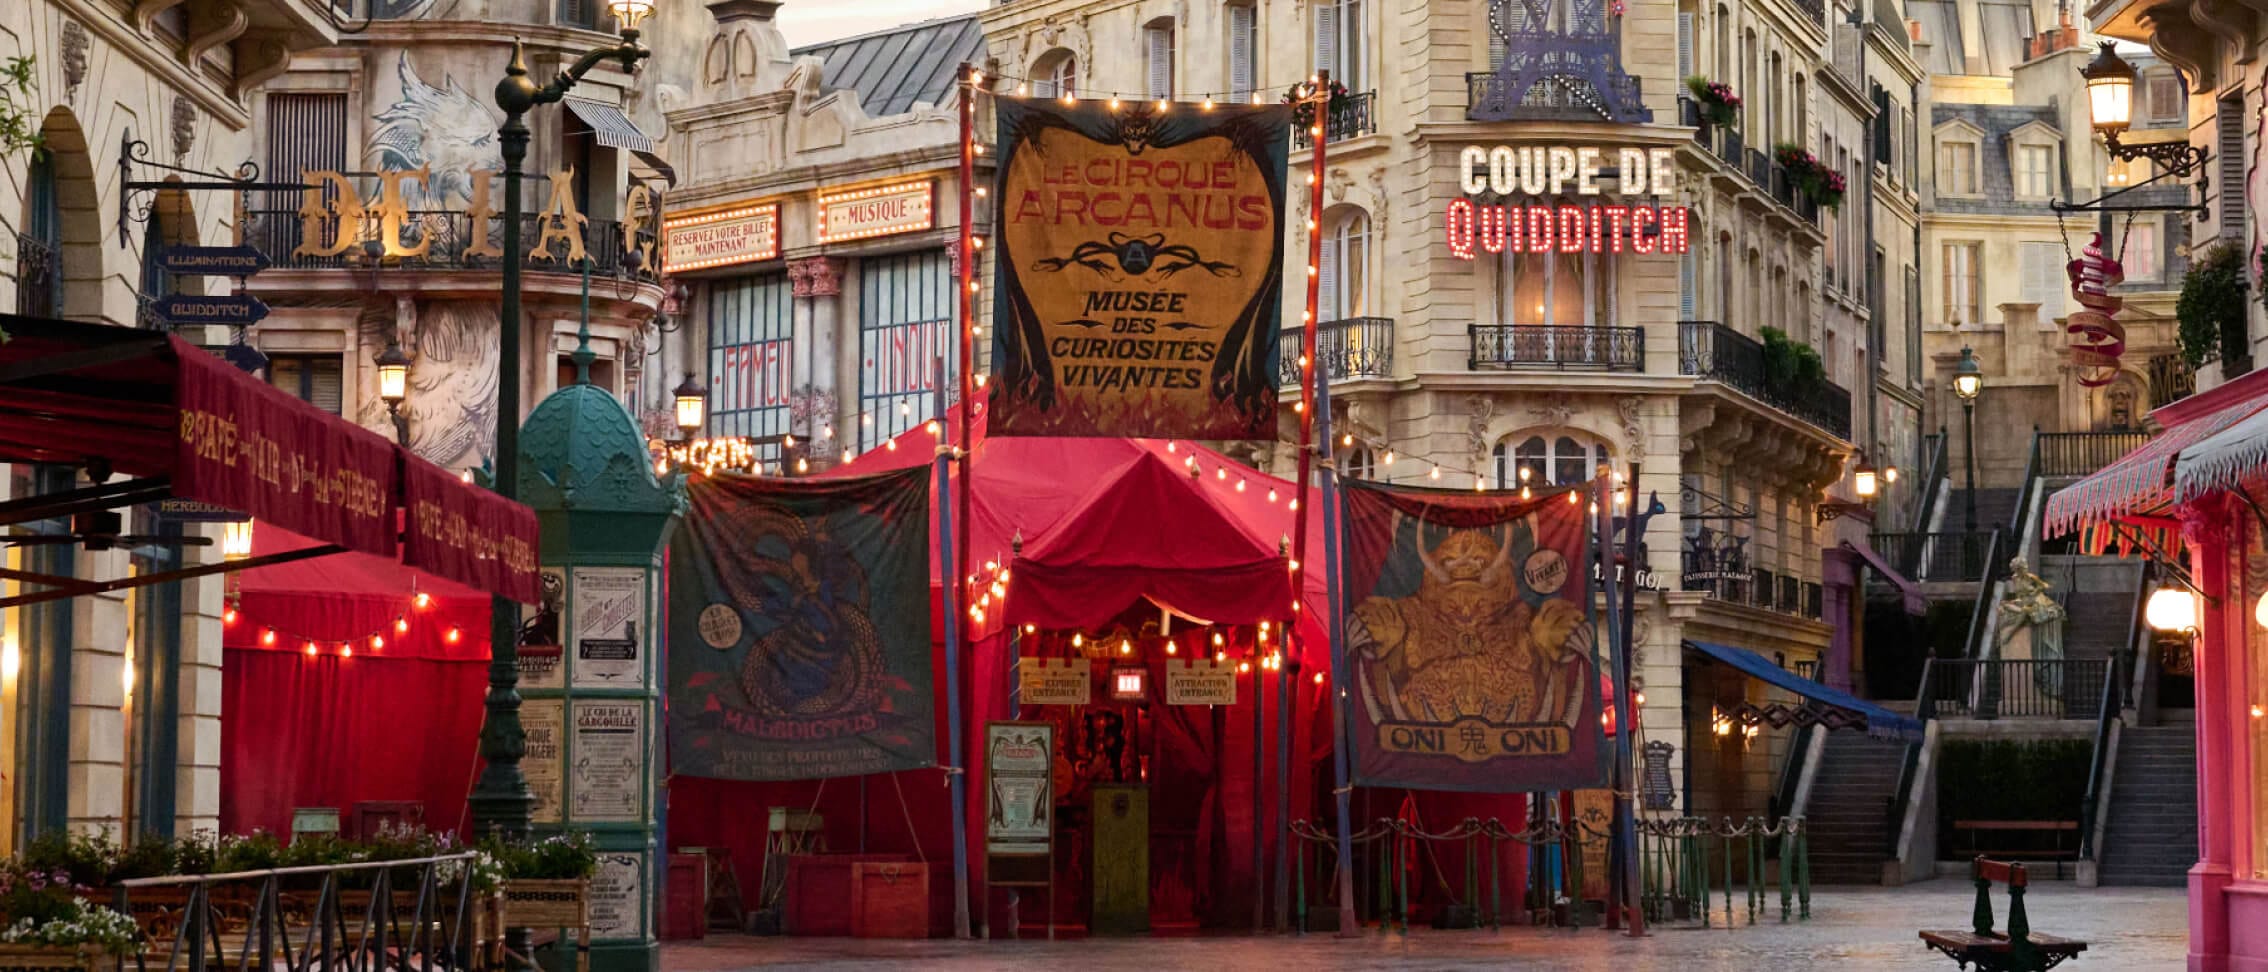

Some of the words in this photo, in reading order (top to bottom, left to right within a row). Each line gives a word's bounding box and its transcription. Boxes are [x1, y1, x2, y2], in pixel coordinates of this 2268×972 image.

[1042, 163, 1075, 186] LE
[1081, 158, 1237, 190] CIRQUE
[1460, 145, 1600, 195] COUPE
[1618, 147, 1673, 195] DE
[849, 199, 908, 225] MUSIQUE
[1013, 189, 1268, 231] ARCANUS
[715, 226, 741, 240] VOTRE
[743, 222, 769, 236] BILLET
[1446, 196, 1689, 260] QUIDDITCH
[694, 237, 747, 257] MAINTENANT
[171, 303, 249, 316] QUIDDITCH
[1083, 287, 1187, 317] MUSÉE
[1111, 317, 1156, 335] DES
[1051, 333, 1217, 363] CURIOSITÉS
[1062, 365, 1202, 393] VIVANTES
[1179, 688, 1224, 698] ENTRANCE
[1391, 727, 1445, 752] ONI
[1459, 723, 1489, 755] 鬼
[1501, 729, 1558, 753] ONI
